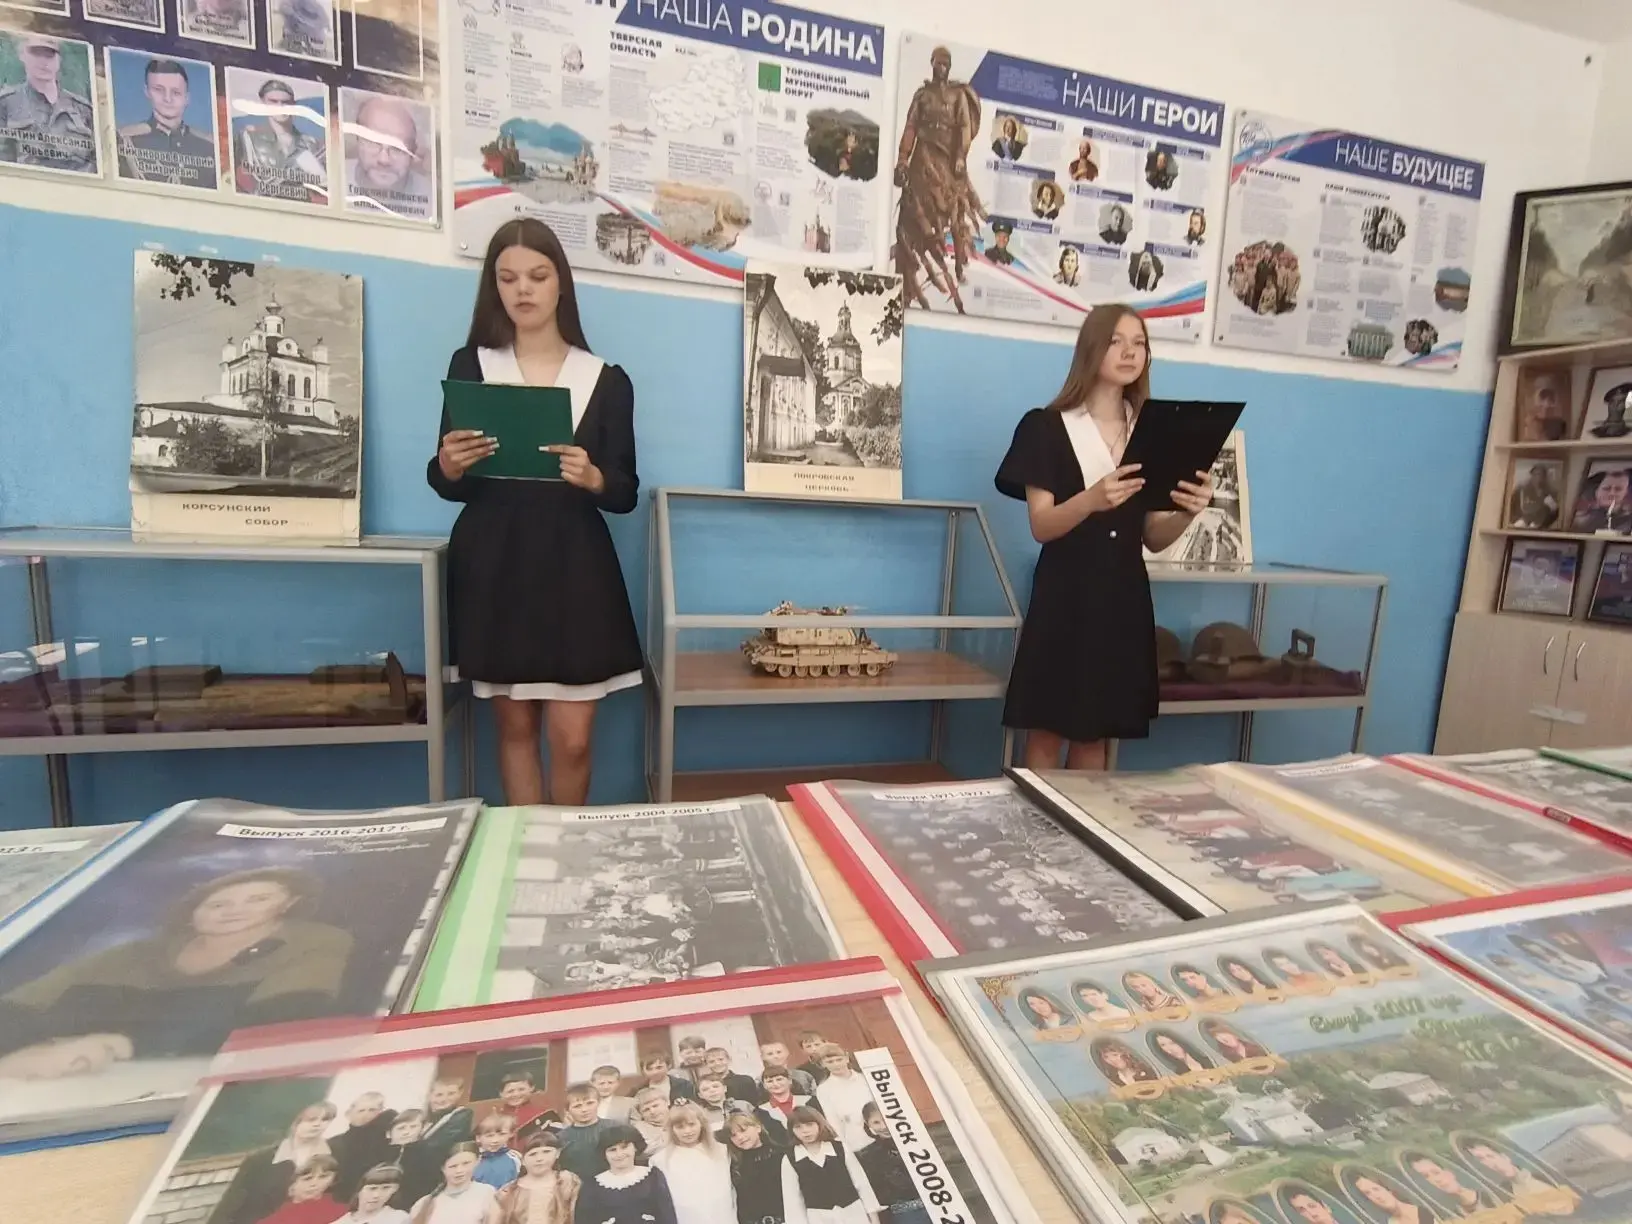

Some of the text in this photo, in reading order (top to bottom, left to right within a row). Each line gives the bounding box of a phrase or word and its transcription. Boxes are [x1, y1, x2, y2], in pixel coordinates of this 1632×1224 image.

[610, 31, 662, 48] ТВЕРСКАЯ
[637, 0, 877, 64] НАША РОДИНА
[610, 42, 656, 58] ОБЛАСТЬ
[786, 66, 847, 84] ТОРОПЕЦКИЙ
[785, 77, 870, 99] МУНИЦИПАЛЬНЫЙ
[785, 88, 814, 99] ОКРУГ
[1063, 78, 1136, 119] НАШИ
[1140, 96, 1218, 136] ГЕРОИ
[1335, 139, 1475, 191] НАШЕ БУДУЩЕЕ
[244, 518, 289, 526] СОБОР
[578, 812, 629, 820] Выпуск
[239, 827, 304, 838] Выпуск
[871, 1068, 917, 1145] Выпуск
